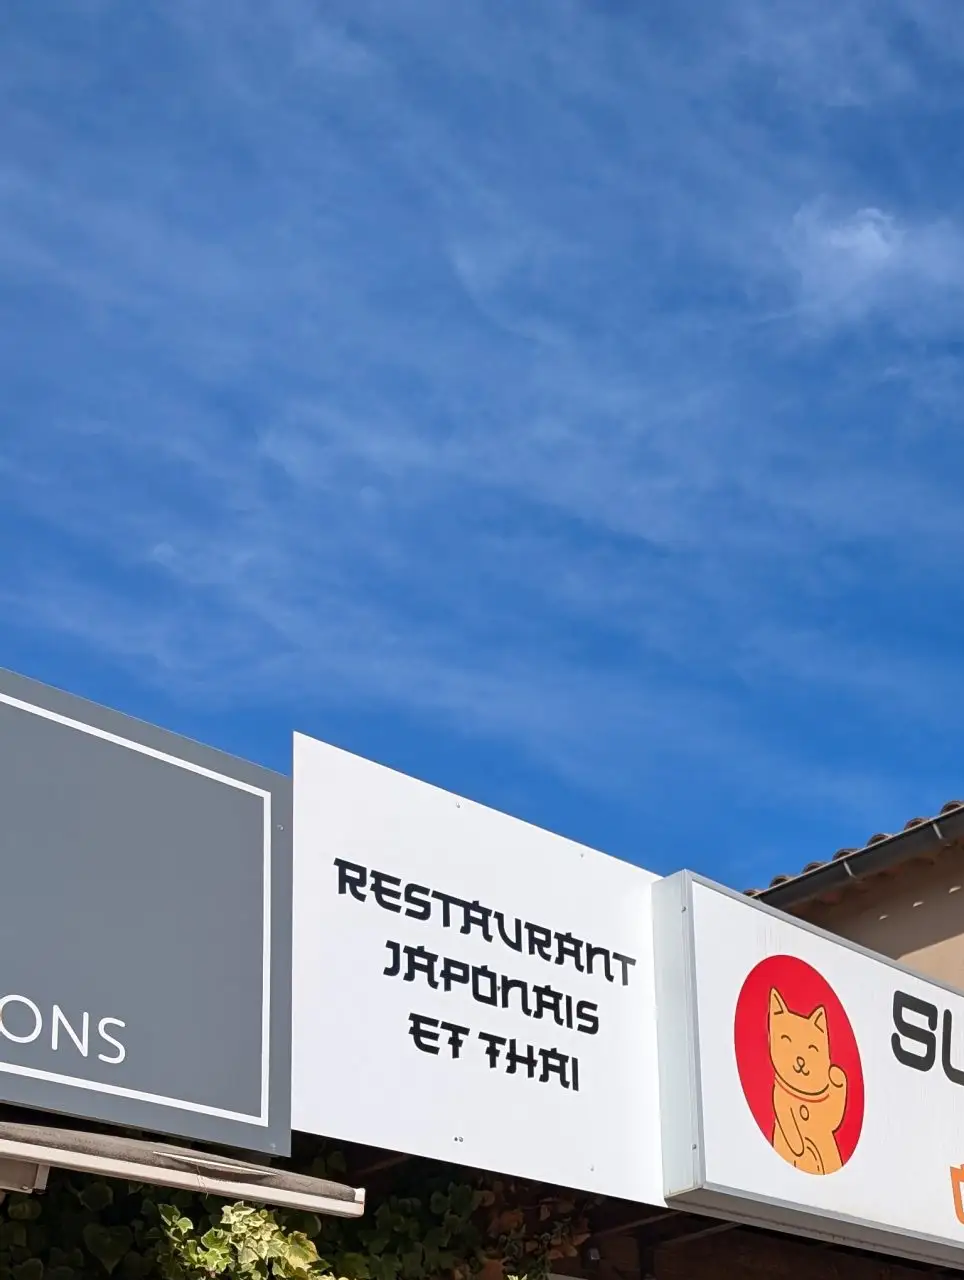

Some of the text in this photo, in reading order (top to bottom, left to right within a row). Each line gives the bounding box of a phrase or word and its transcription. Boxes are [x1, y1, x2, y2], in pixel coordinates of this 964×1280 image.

[334, 858, 637, 986] RESTAURANT
[383, 940, 600, 1035] JAPONAIS
[408, 1013, 579, 1092] ET THAI
